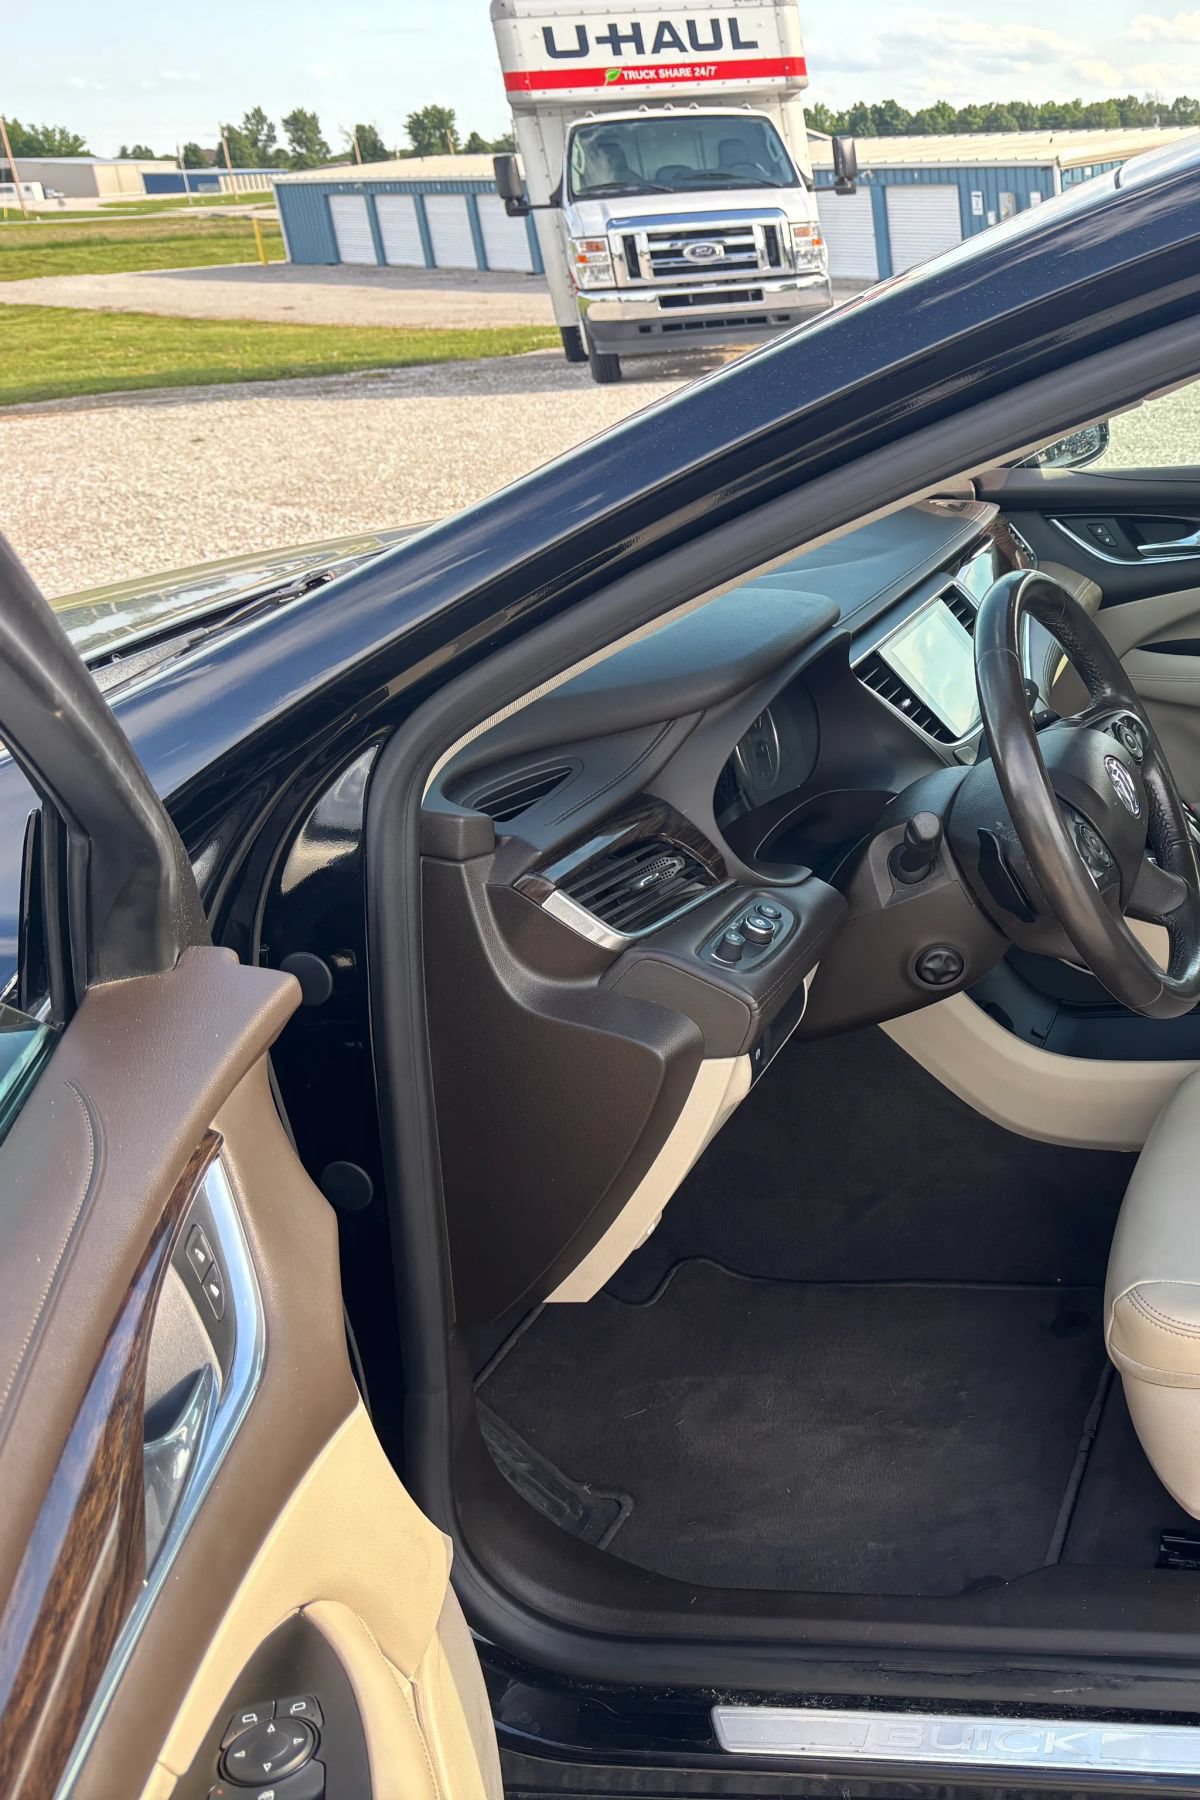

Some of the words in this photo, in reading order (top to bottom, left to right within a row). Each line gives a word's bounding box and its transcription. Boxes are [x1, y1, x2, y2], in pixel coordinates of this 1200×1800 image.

[541, 17, 759, 59] U-HAUL
[622, 69, 657, 81] TRUCK
[658, 67, 693, 79] SHARE
[693, 65, 717, 77] 24/7
[883, 1723, 1090, 1756] BUICK
